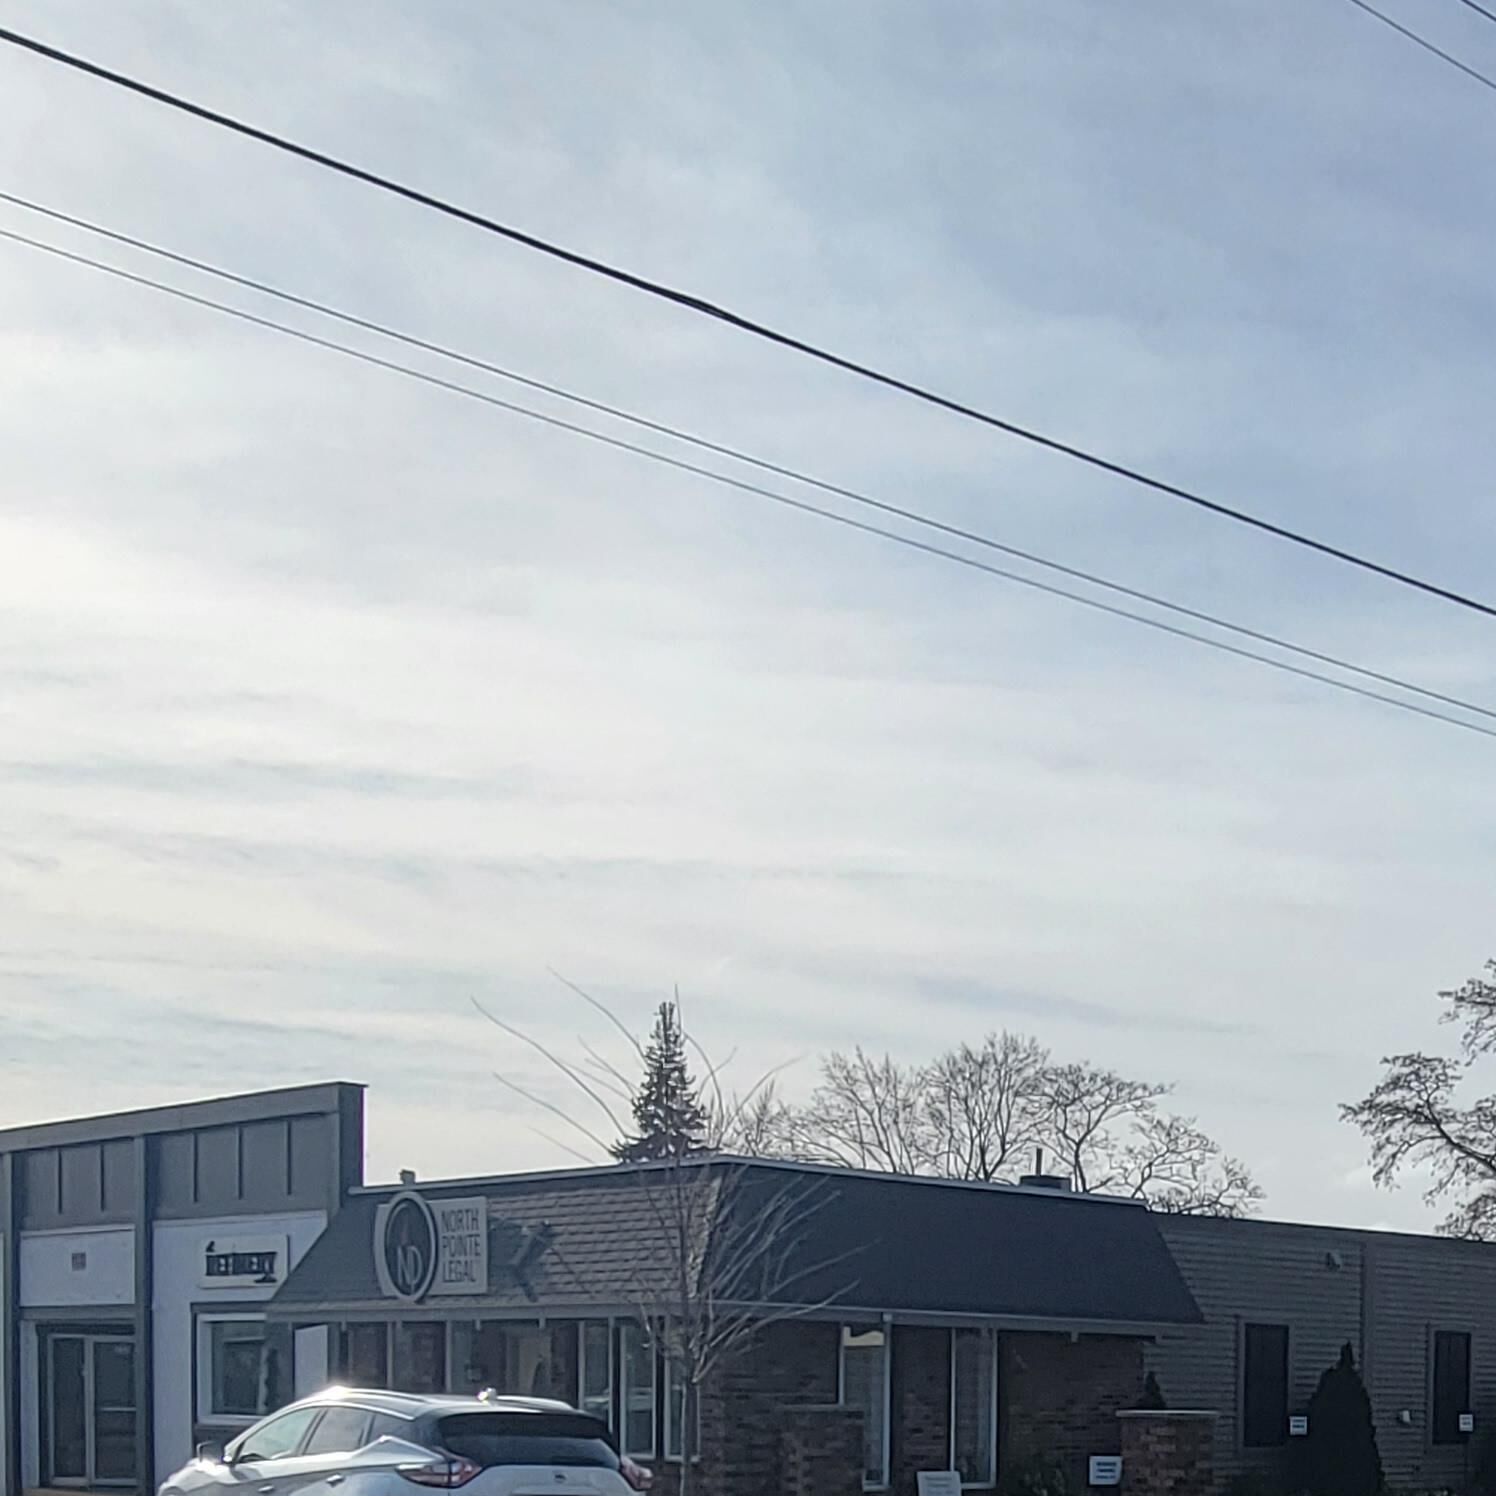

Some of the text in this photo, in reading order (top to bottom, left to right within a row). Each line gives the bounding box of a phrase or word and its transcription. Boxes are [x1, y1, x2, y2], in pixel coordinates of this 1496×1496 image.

[441, 1208, 479, 1232] NORTH
[441, 1234, 480, 1257] POINTE
[442, 1260, 477, 1283] LEGAL
